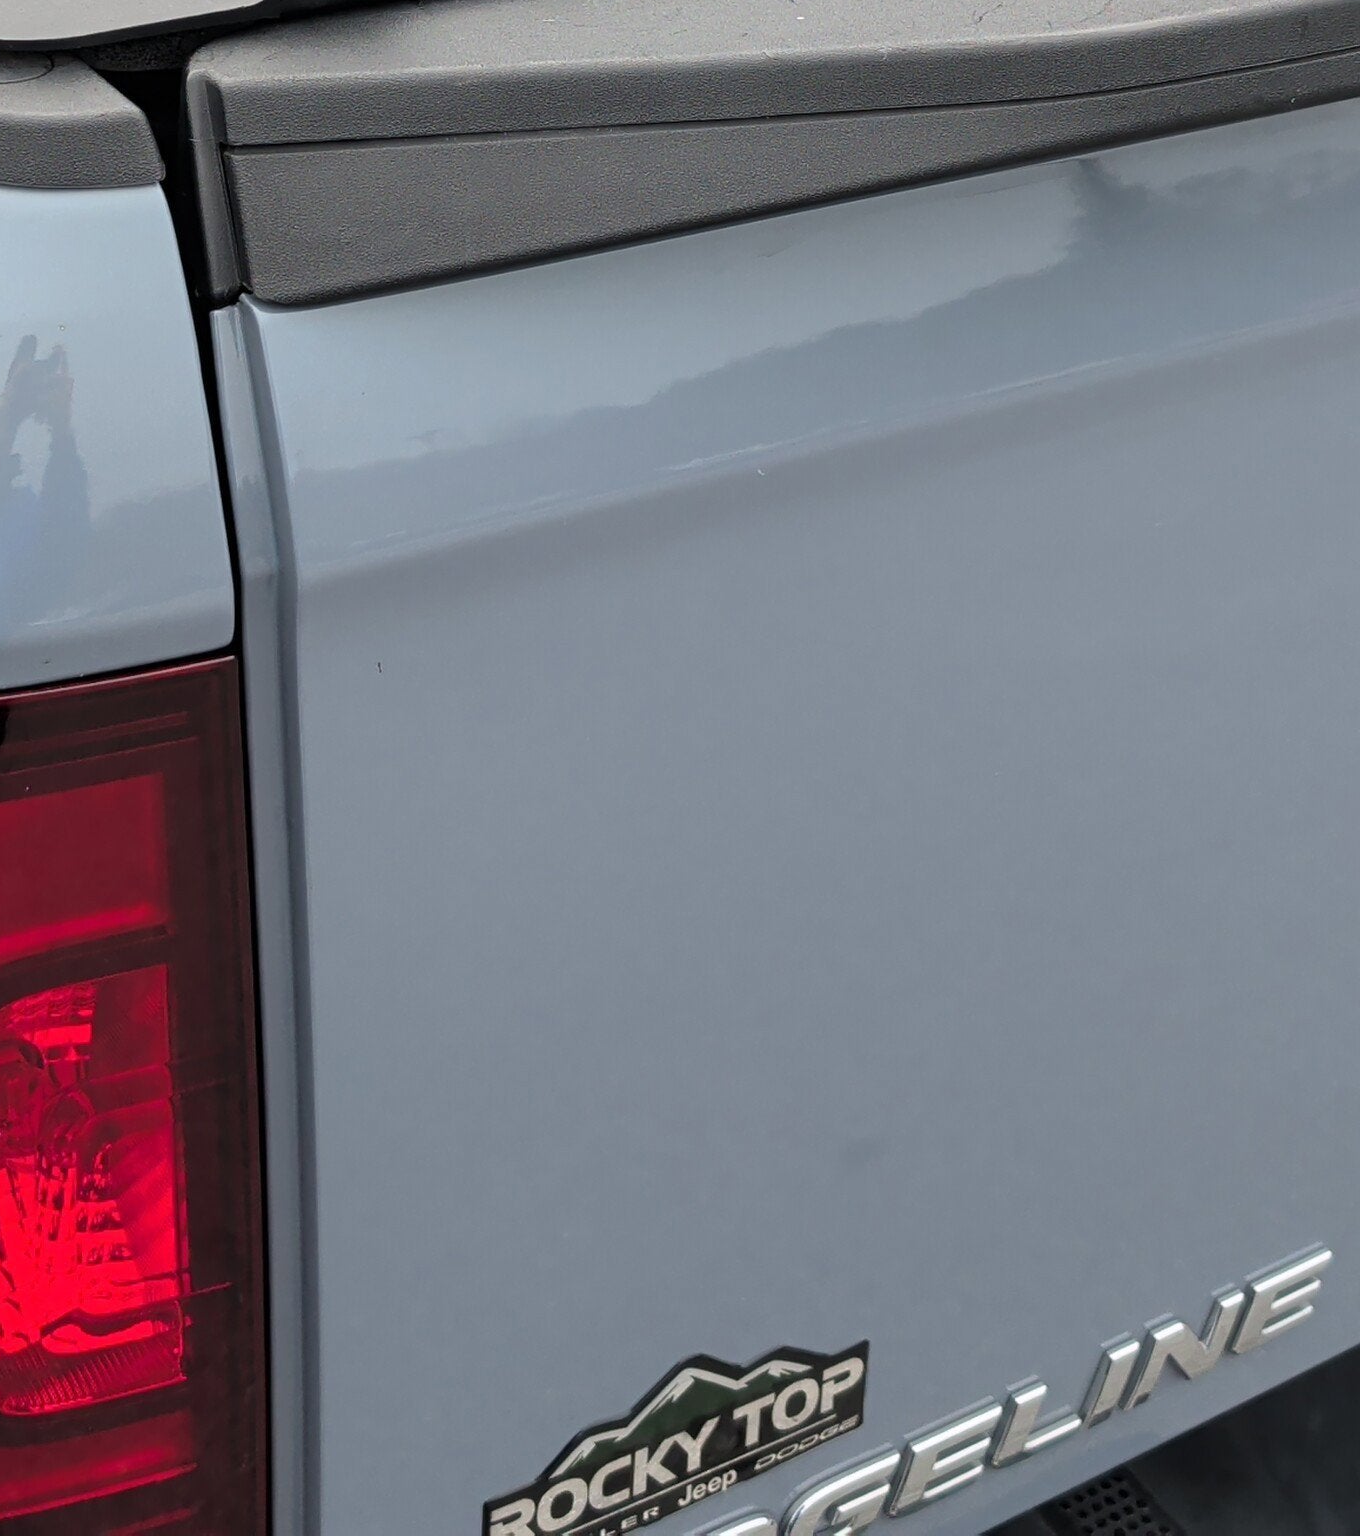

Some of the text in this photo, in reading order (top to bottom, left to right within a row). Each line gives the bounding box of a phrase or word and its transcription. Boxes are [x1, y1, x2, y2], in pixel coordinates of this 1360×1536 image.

[490, 1357, 865, 1536] ROCKY TOP
[678, 1468, 738, 1506] Jeep
[753, 1413, 859, 1471] DODGE
[696, 1244, 1333, 1536] GELINE
